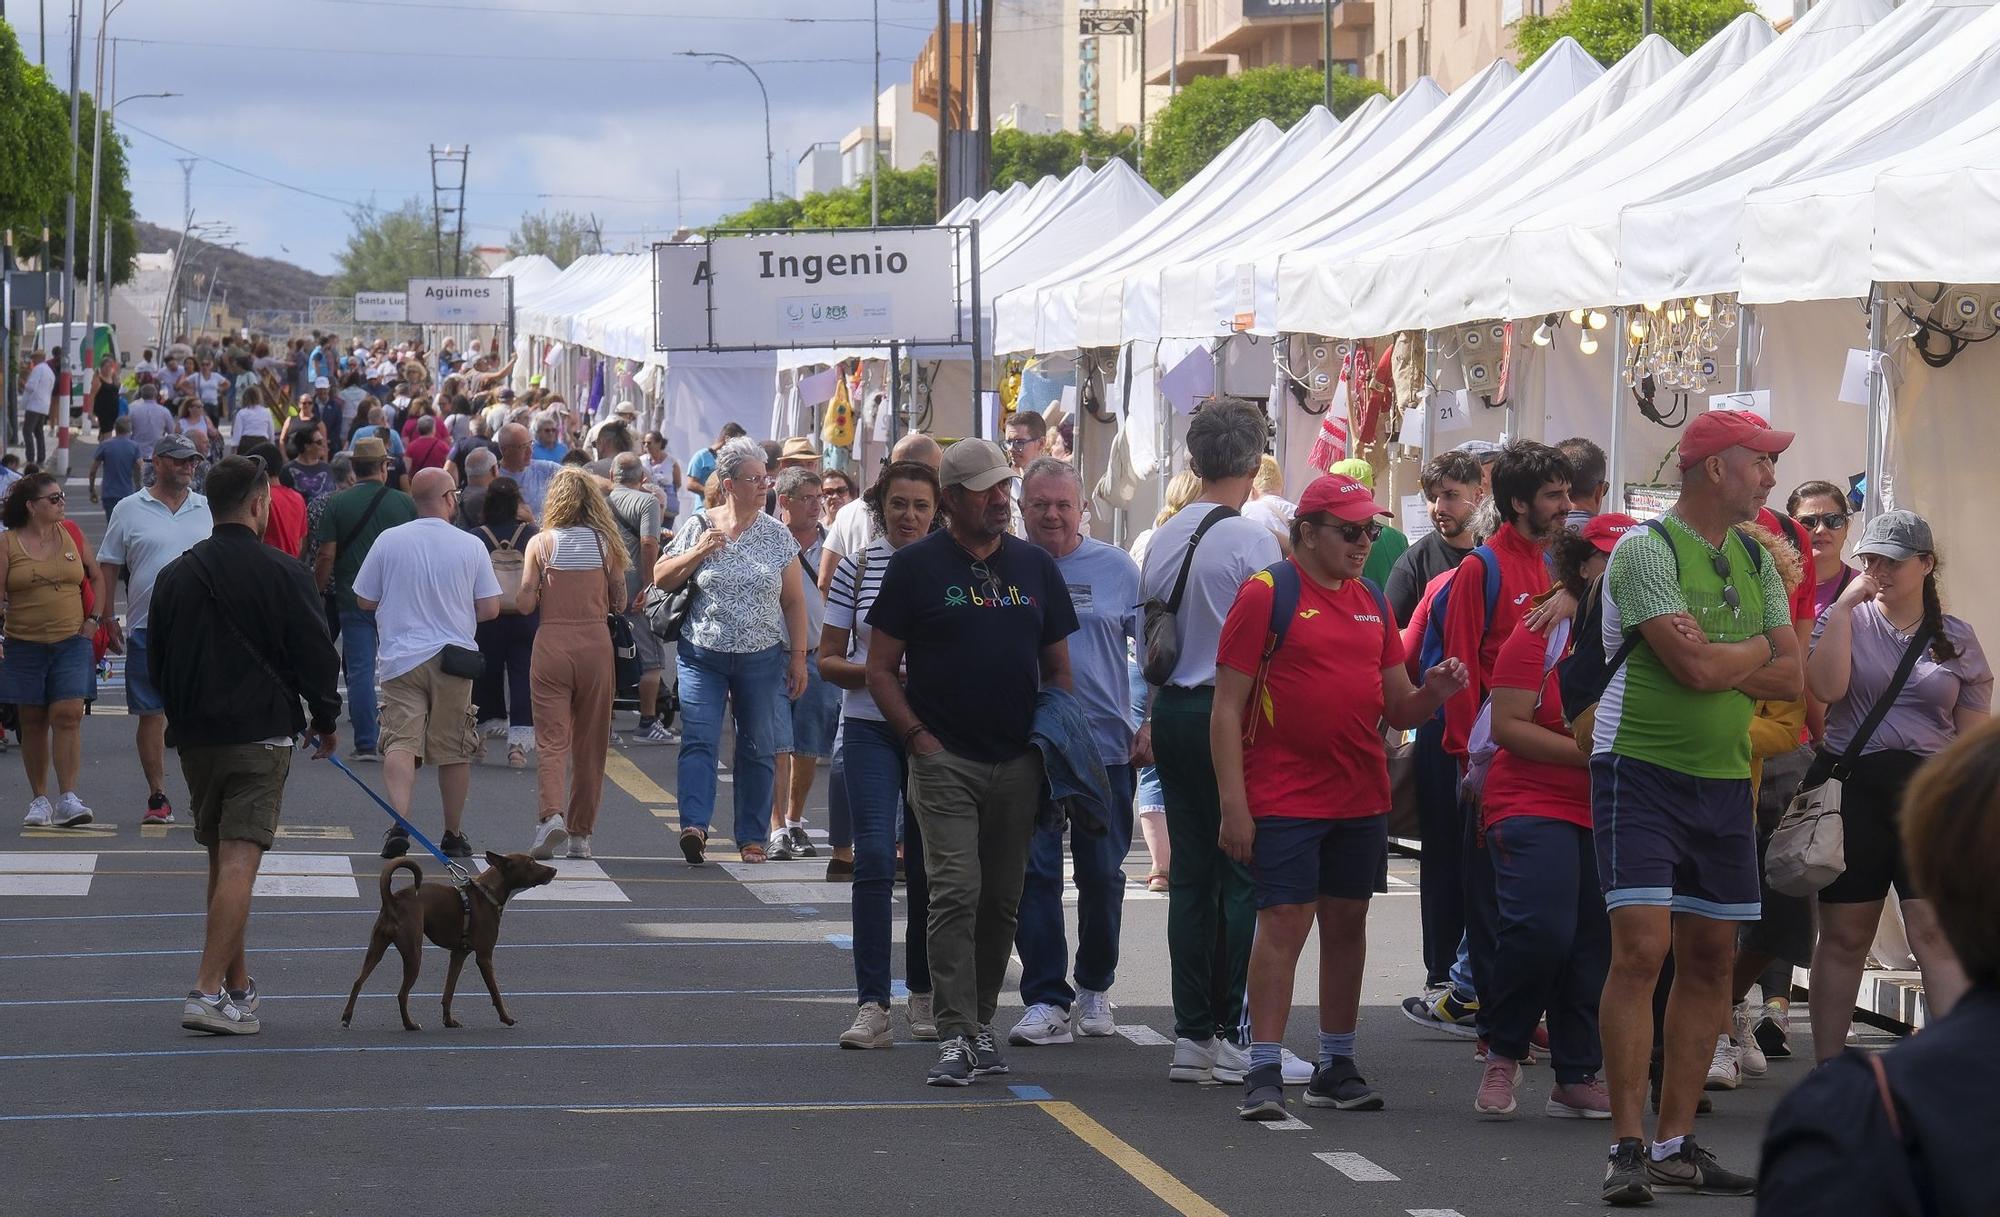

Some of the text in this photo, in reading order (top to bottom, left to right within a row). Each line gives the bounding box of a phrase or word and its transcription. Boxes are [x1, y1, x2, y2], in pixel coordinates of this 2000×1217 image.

[759, 245, 908, 284] Ingenio
[425, 286, 490, 300] Agüimes
[358, 297, 386, 305] Santa
[1440, 407, 1453, 420] 21
[1353, 614, 1381, 623] envera
